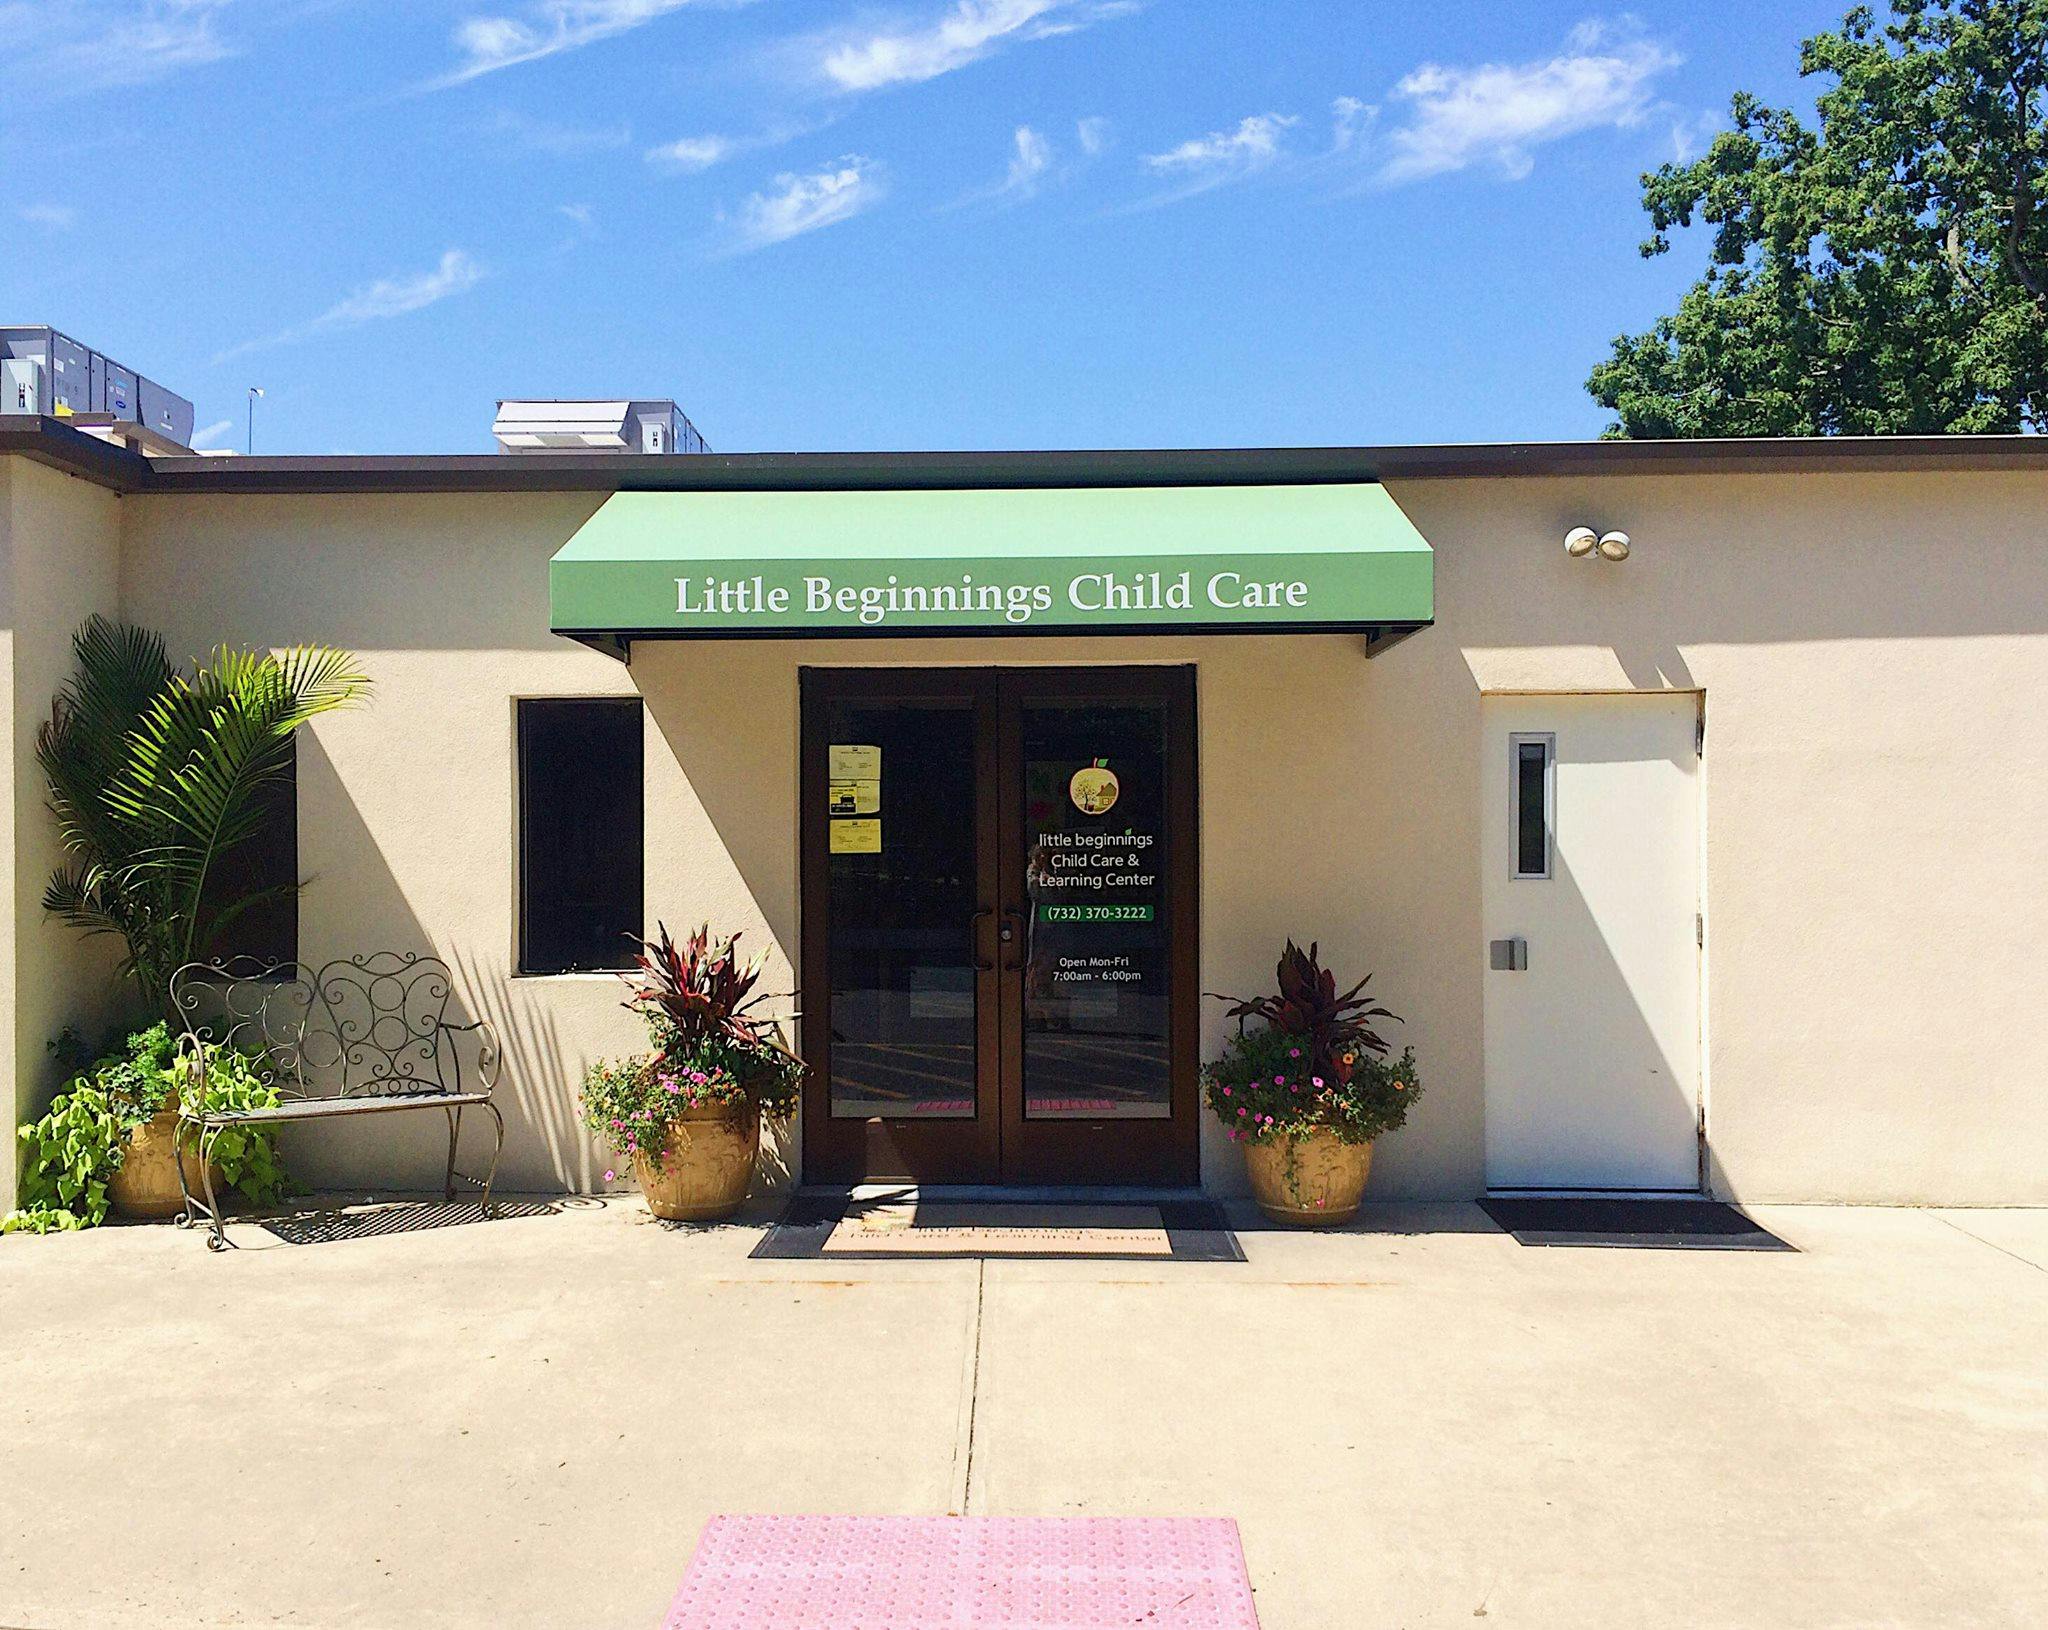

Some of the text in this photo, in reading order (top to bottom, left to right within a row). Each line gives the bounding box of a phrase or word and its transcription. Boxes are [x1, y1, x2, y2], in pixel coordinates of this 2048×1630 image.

[672, 571, 1309, 625] Little Beginnings Child Care
[1038, 832, 1153, 850] little beginnings
[1051, 854, 1140, 868] Child Care &
[1038, 872, 1156, 890] Learning Center
[1047, 906, 1148, 921] (732) 370-3222
[1059, 956, 1130, 970] Open Mon-Fri
[1052, 971, 1093, 982] 7:00am
[1101, 970, 1142, 983] 6:00pm
